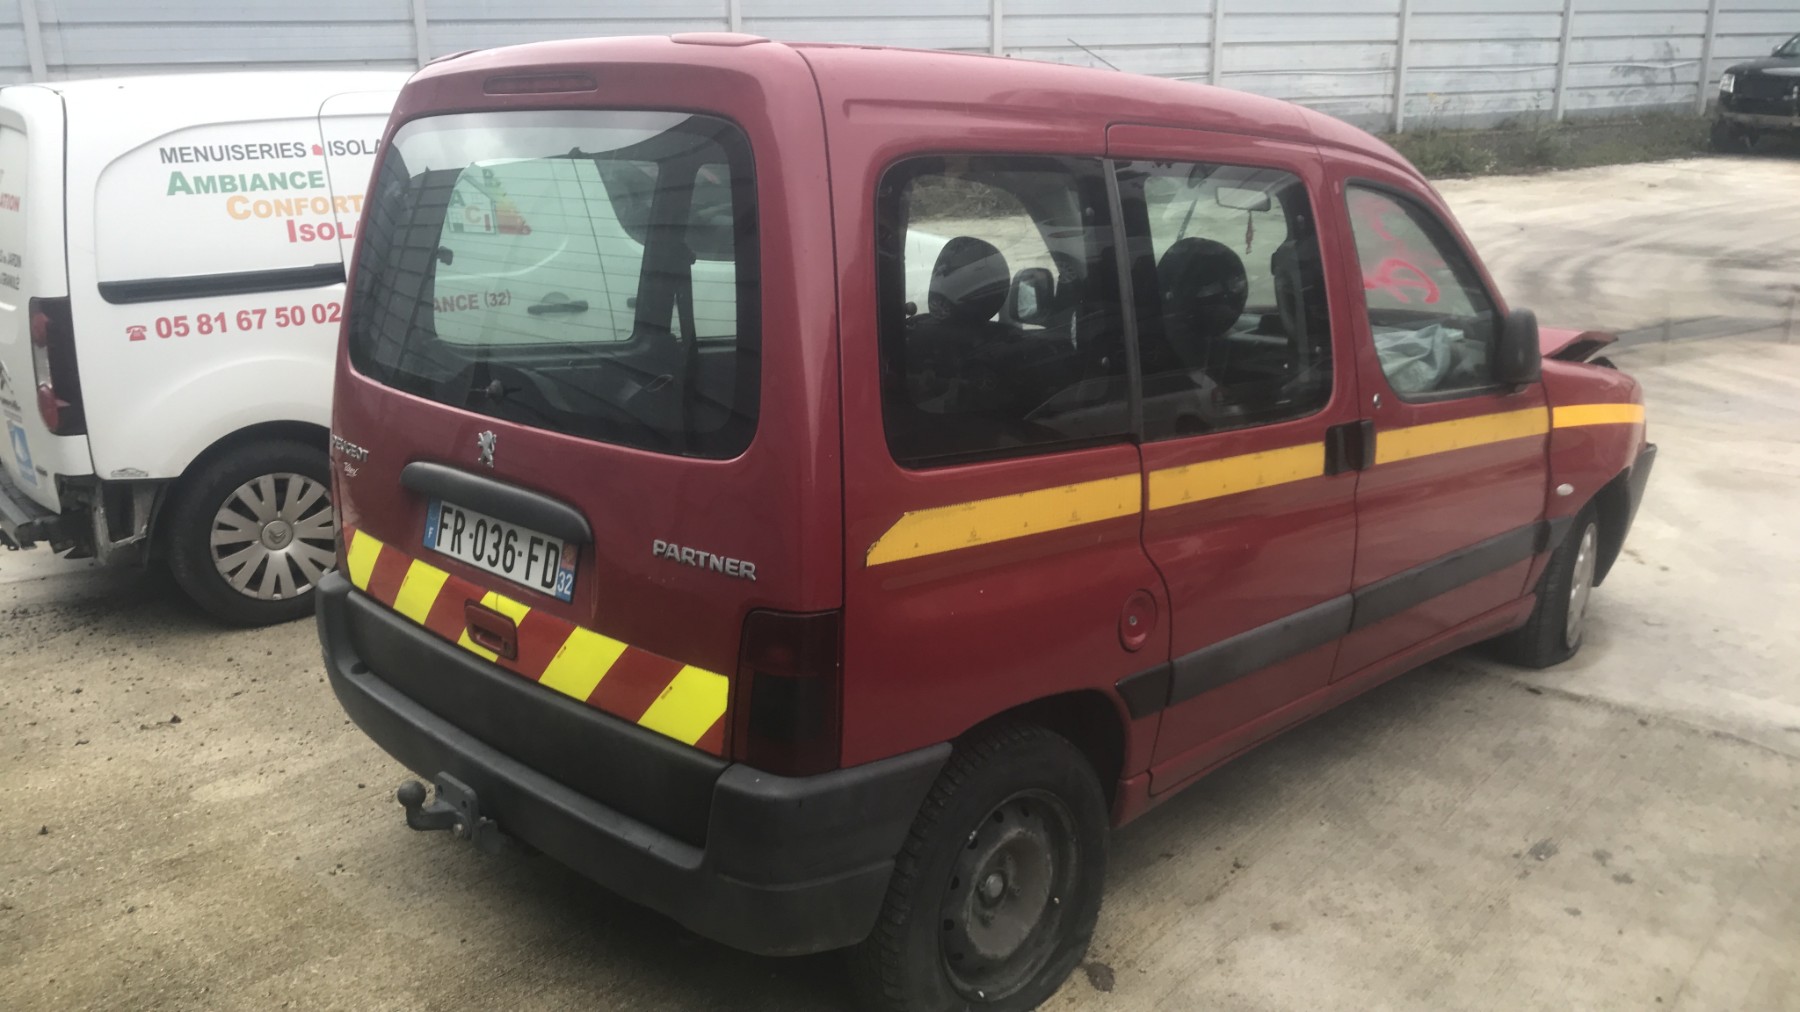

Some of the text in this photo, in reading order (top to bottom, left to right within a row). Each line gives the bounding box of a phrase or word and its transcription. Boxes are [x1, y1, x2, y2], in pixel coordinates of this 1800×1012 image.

[159, 142, 307, 164] MENUISERIES
[167, 170, 325, 196] AMBIANCE
[226, 194, 363, 221] CONFORT
[286, 220, 360, 243] ISOL
[155, 302, 342, 339] 05 81 67 50 02
[437, 505, 560, 589] FR-036-FD
[652, 539, 756, 581] PARTNER
[557, 571, 573, 594] 32
